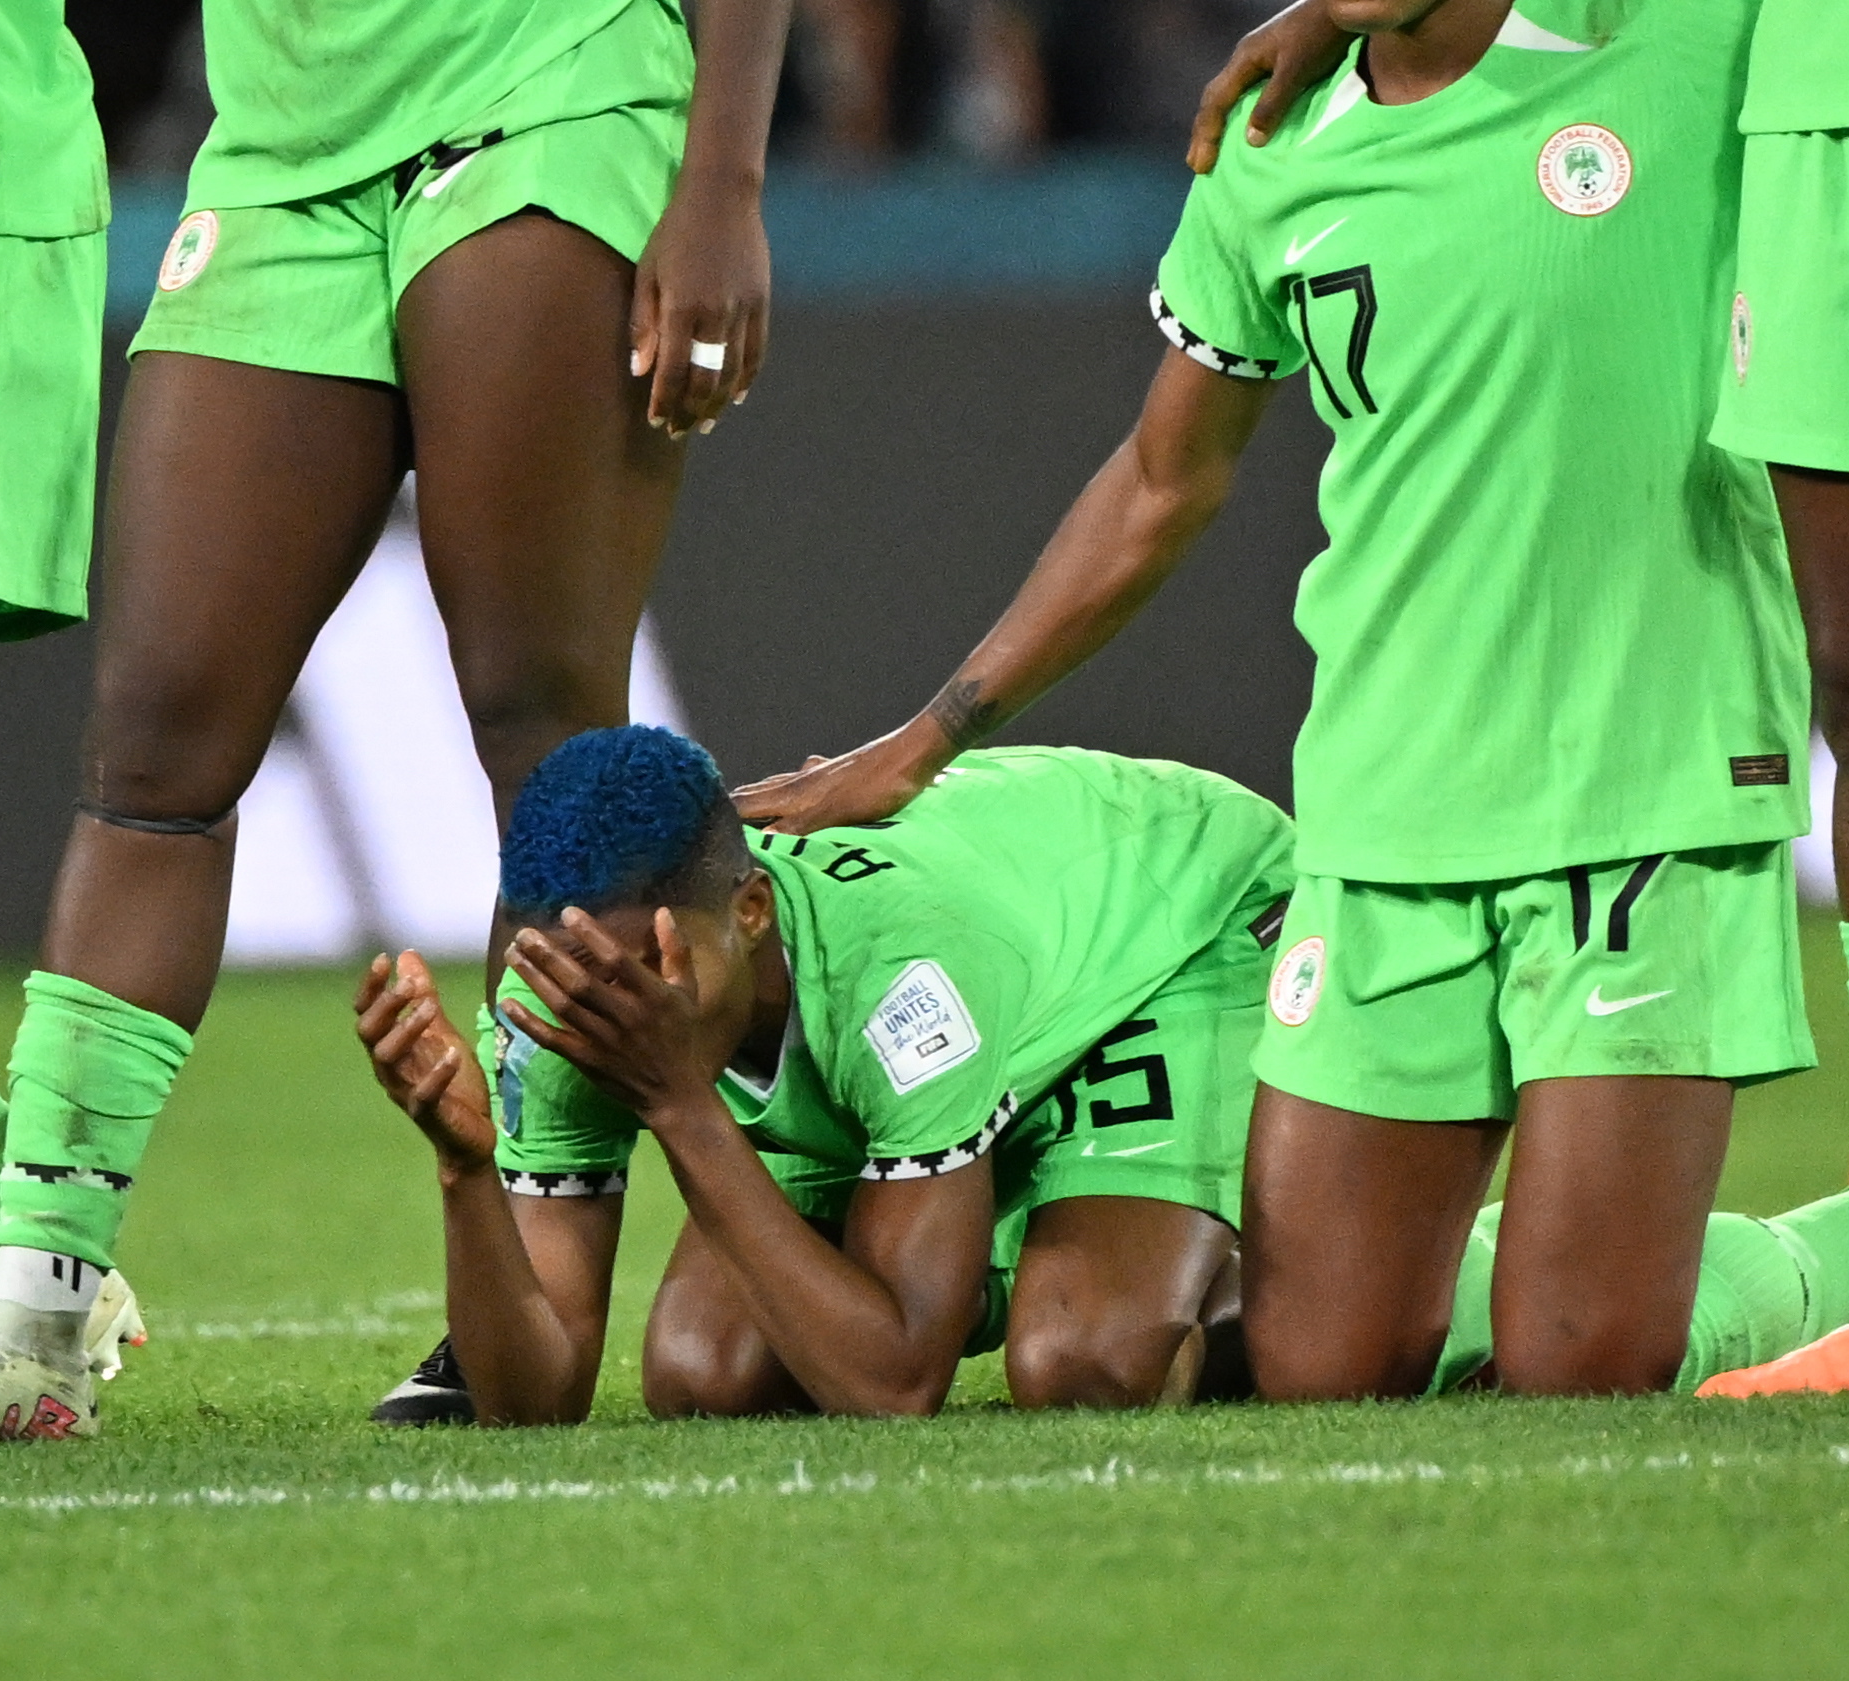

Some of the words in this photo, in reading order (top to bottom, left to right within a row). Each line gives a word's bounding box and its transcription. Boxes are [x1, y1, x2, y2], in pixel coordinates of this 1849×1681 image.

[1543, 129, 1595, 160] FOOTBALL
[1291, 263, 1378, 419] 17
[878, 980, 929, 1019] FOOTBALL
[884, 991, 940, 1034] UNITES
